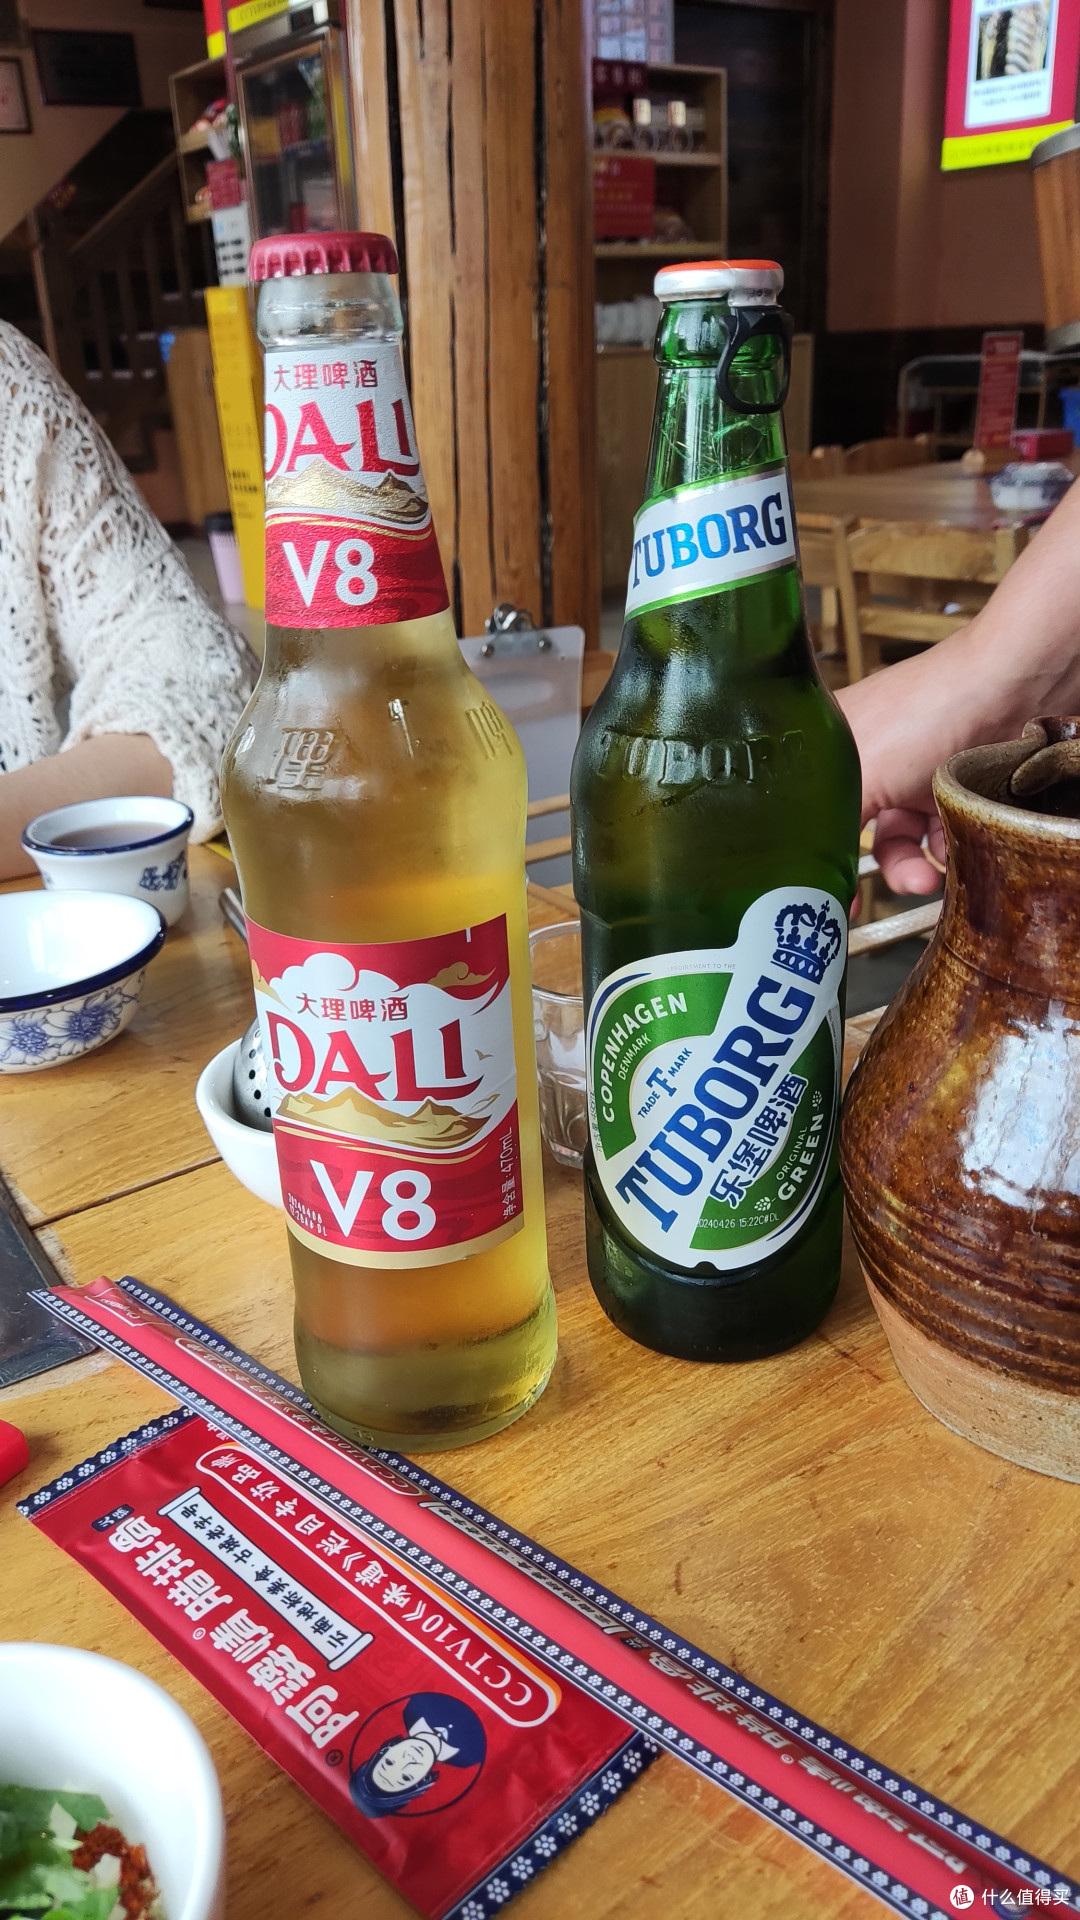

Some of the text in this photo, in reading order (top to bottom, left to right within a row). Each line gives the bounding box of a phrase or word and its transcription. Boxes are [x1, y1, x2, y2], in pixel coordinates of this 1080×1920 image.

[273, 359, 378, 393] 大理啤酒
[282, 538, 379, 607] V8
[632, 491, 788, 590] TUBORG
[296, 992, 410, 1023] 大理啤酒
[266, 1010, 485, 1102] DALI
[600, 992, 688, 1123] COPENHAGEN
[617, 1032, 652, 1081] DENMARK
[637, 1090, 661, 1119] TRADE
[667, 1047, 693, 1078] MARK
[614, 973, 816, 1233] TUBORG
[709, 1073, 808, 1208] 乐堡啤酒
[776, 1126, 808, 1181] ORIGINAL
[777, 1113, 824, 1201] GREEN
[309, 1159, 437, 1242] V8
